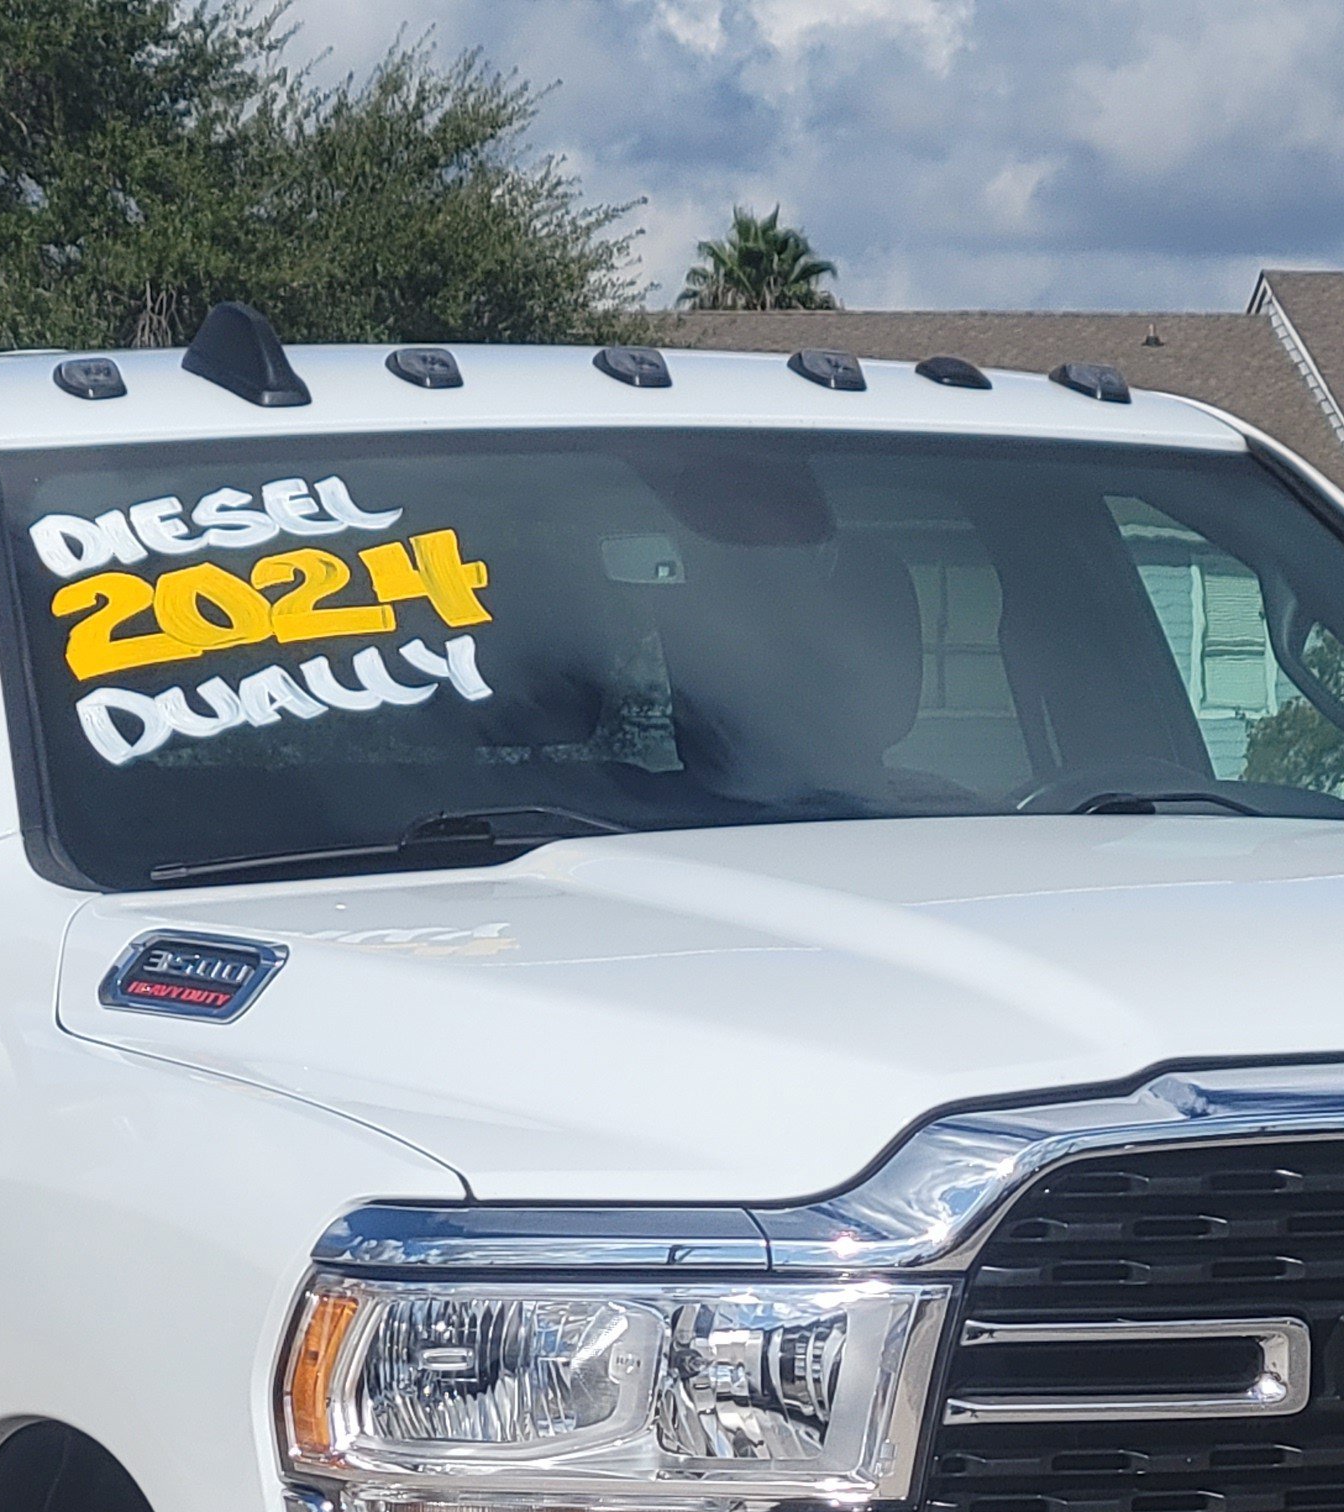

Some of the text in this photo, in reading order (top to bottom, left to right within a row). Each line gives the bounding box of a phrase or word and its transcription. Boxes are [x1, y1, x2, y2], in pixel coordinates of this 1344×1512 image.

[29, 475, 404, 578] DIESEL
[51, 528, 494, 681] 2024
[75, 634, 494, 767] DUALLY
[127, 980, 232, 1006] HEAVY DUTY
